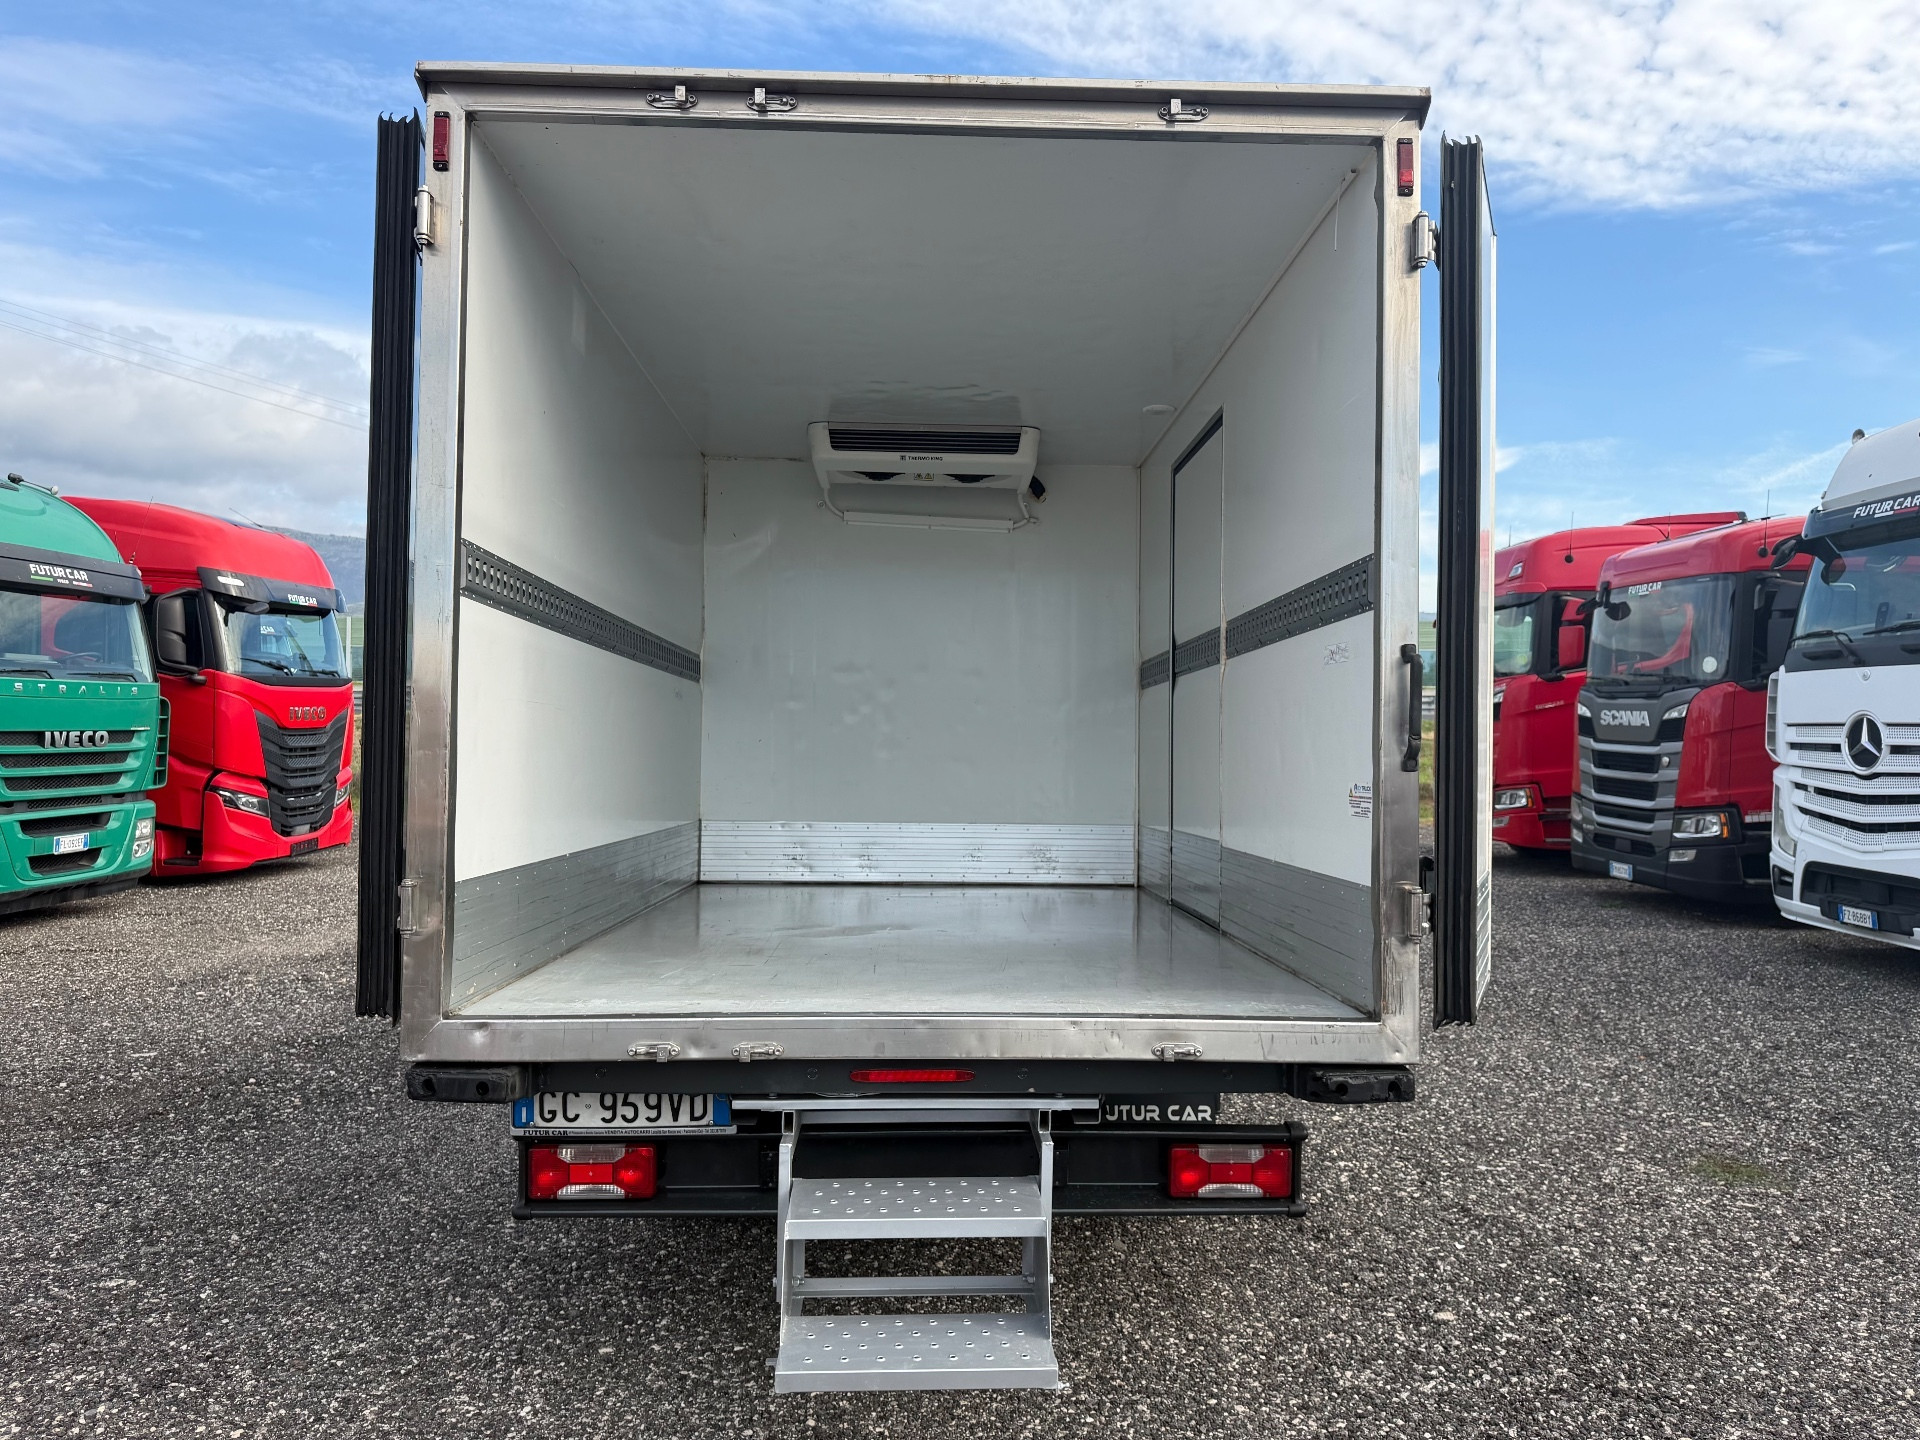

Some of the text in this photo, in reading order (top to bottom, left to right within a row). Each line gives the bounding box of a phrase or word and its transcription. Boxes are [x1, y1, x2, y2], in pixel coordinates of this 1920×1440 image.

[1853, 500, 1893, 518] FUTUR
[29, 563, 66, 579] FUTUR
[67, 568, 89, 581] CAR
[1628, 581, 1662, 594] FUTUR CAR
[13, 682, 138, 695] STRALIS
[289, 706, 326, 721] IVECO
[1600, 709, 1650, 726] SCANIA
[44, 730, 109, 749] IVECO
[1105, 1105, 1212, 1121] UTUR CAR
